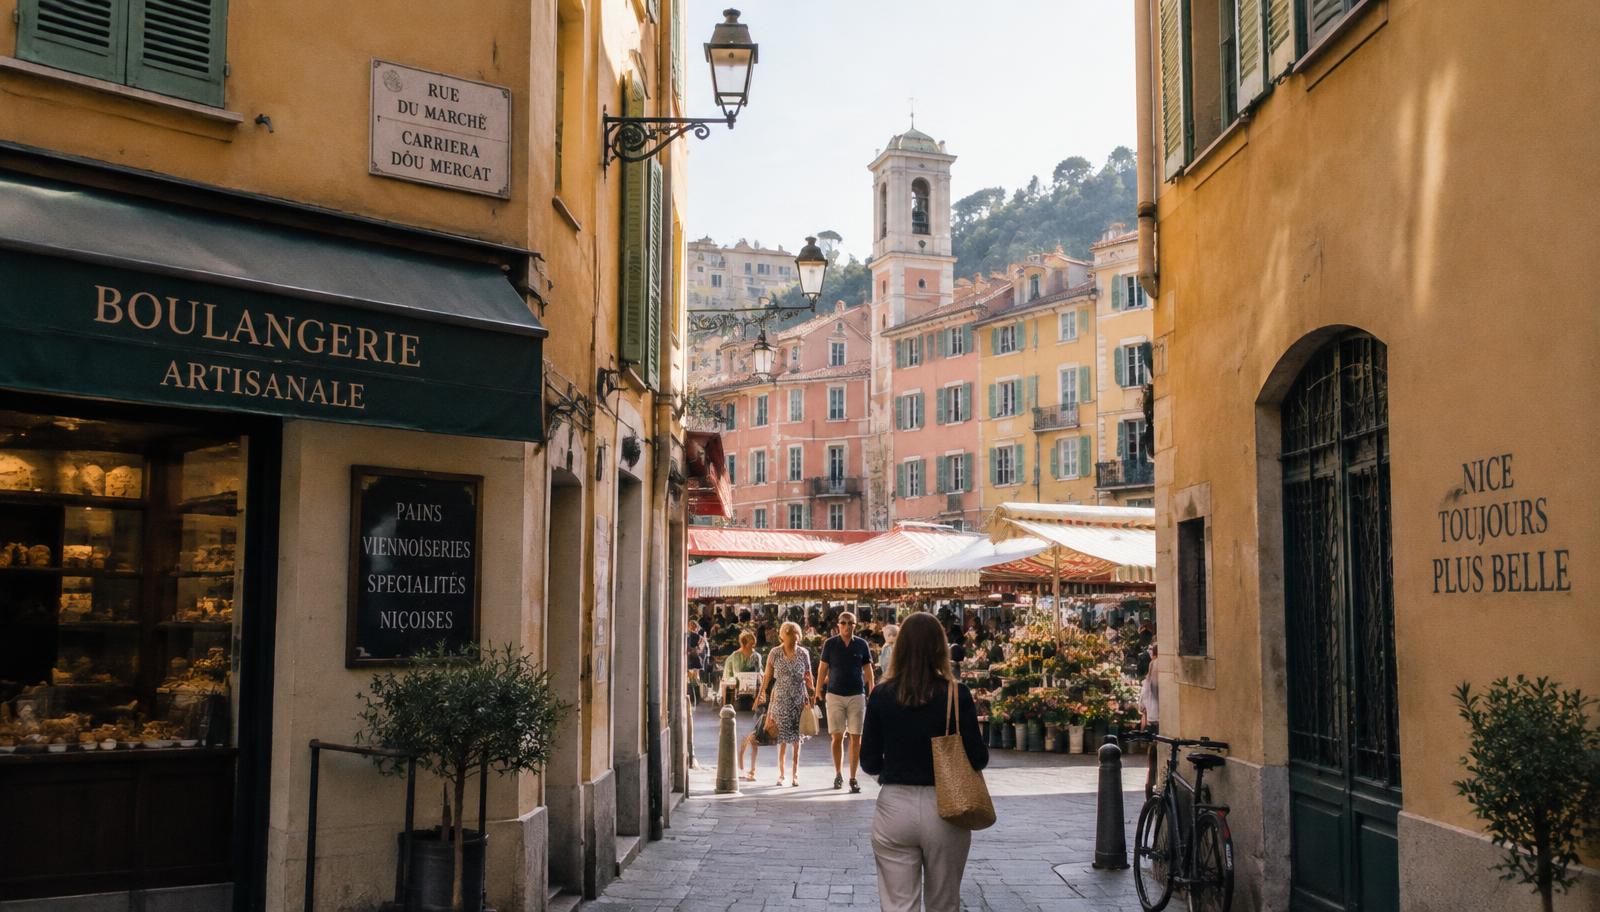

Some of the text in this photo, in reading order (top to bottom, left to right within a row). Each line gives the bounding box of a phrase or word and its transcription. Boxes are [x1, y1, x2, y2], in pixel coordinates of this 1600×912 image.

[427, 83, 460, 103] RUE
[397, 99, 419, 116] DU
[402, 131, 480, 158] CARRIERA
[430, 158, 492, 181] MERCAT
[93, 285, 421, 367] BOULANGERIE
[160, 360, 365, 409] ARTISANALE
[1462, 453, 1514, 495] NICE
[396, 502, 442, 522] PAINS
[1438, 497, 1548, 546] TOUJOURS
[1432, 550, 1572, 593] PLUS BELLE
[380, 611, 453, 632] NIÇOISES
